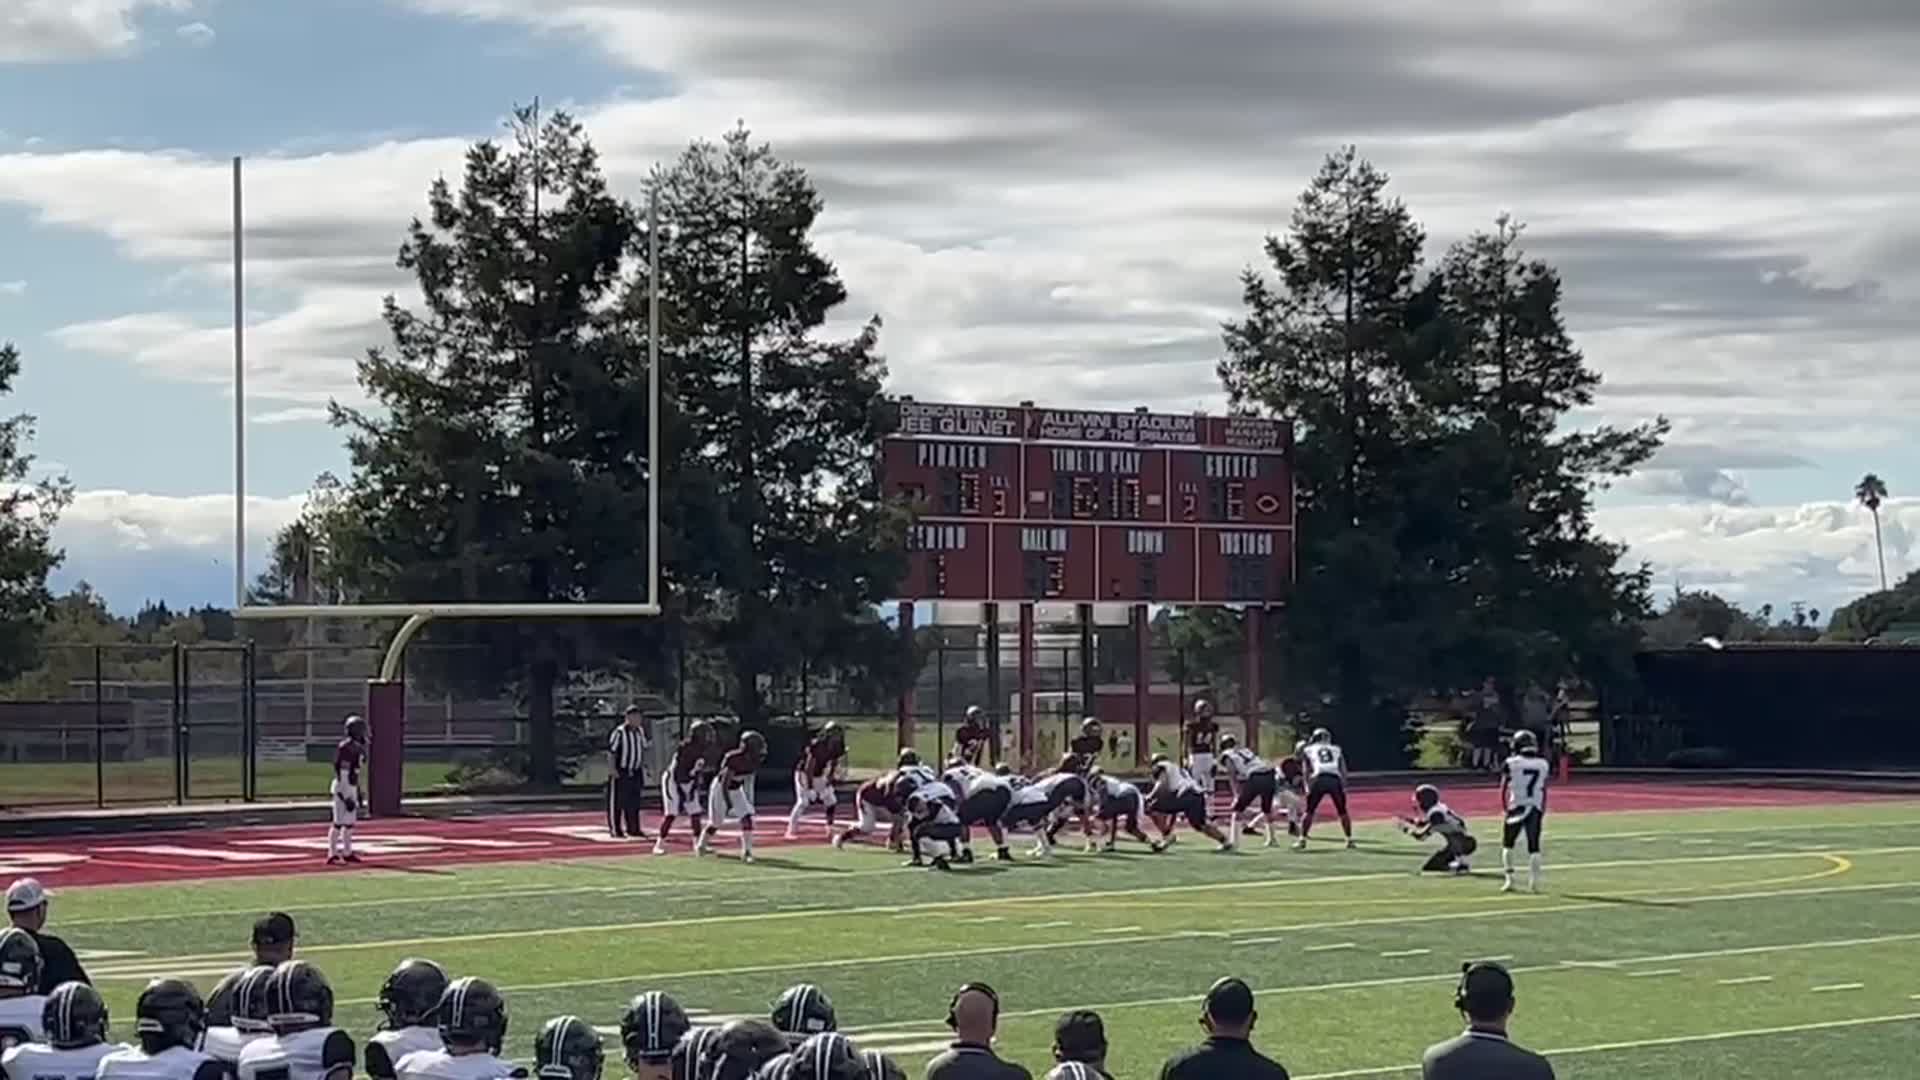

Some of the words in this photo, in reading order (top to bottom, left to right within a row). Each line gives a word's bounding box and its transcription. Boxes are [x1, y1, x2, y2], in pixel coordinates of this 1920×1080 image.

[988, 409, 1008, 419] TO
[1117, 415, 1195, 430] STADIUM
[1086, 428, 1105, 439] OF
[1109, 429, 1136, 440] THE
[1523, 768, 1540, 797] 7
